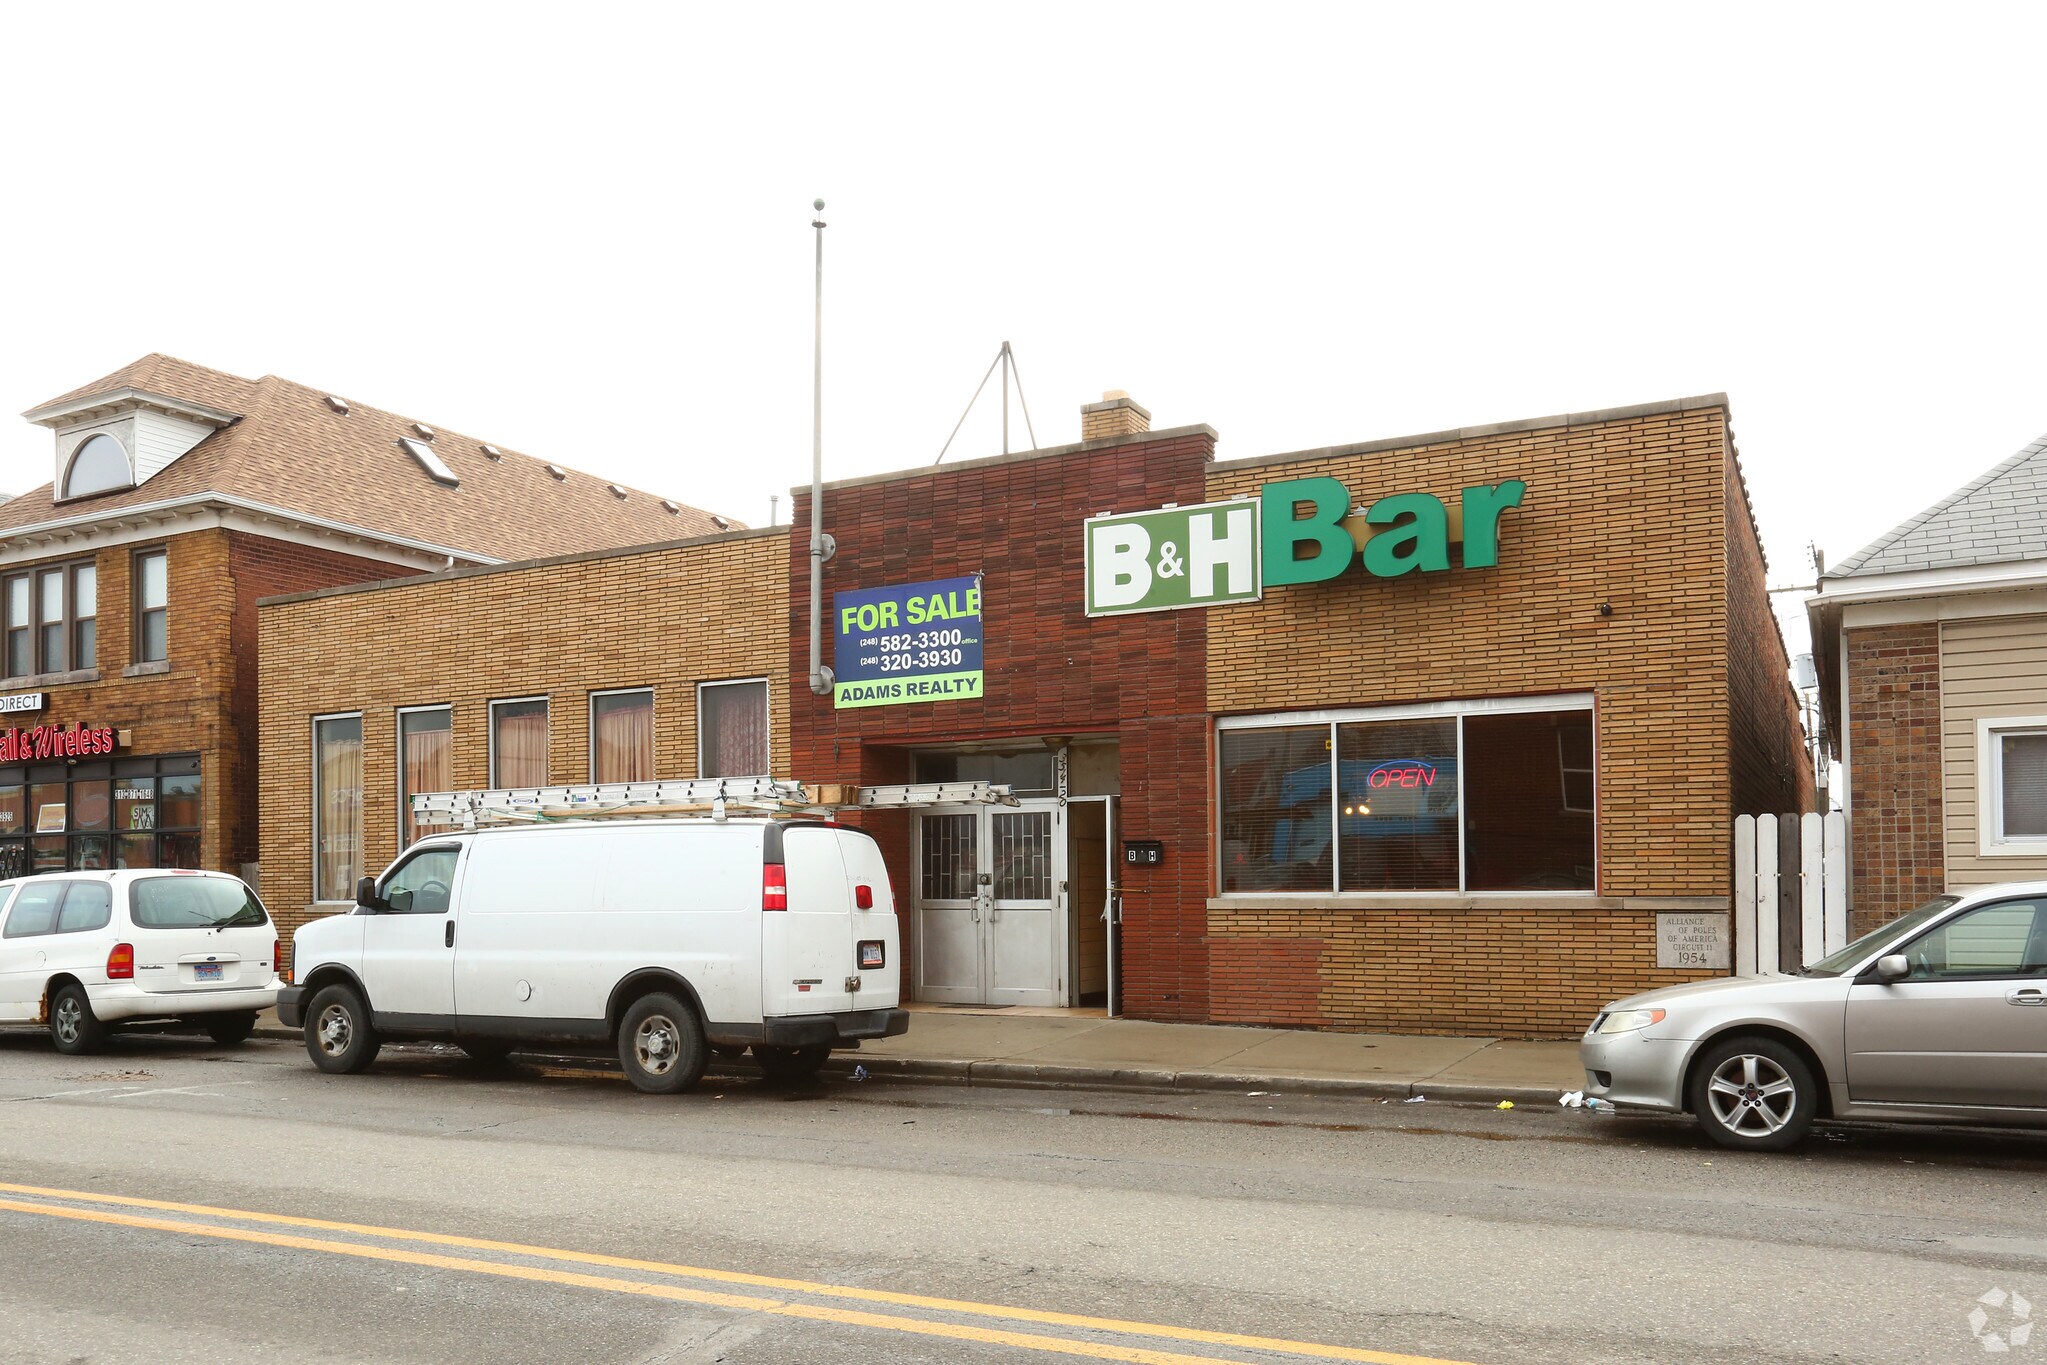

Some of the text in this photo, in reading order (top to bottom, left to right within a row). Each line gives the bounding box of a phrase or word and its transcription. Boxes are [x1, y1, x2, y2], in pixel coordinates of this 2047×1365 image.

[1262, 476, 1527, 587] Bar
[1093, 508, 1252, 608] B&H
[841, 588, 982, 635] FOR SALE
[860, 629, 978, 652] (248) 582-3300 office
[860, 648, 962, 672] (248) 320-3930
[840, 677, 977, 702] ADAMS REALTY
[20, 732, 33, 760] &
[32, 722, 113, 759] Wireless
[1370, 767, 1437, 788] OPEN
[1129, 850, 1156, 861] B H
[1666, 918, 1705, 926] ALLIANCE
[1678, 926, 1717, 934] OF POLES
[1667, 935, 1718, 943] OF AMERICA
[1678, 951, 1707, 965] 1954
